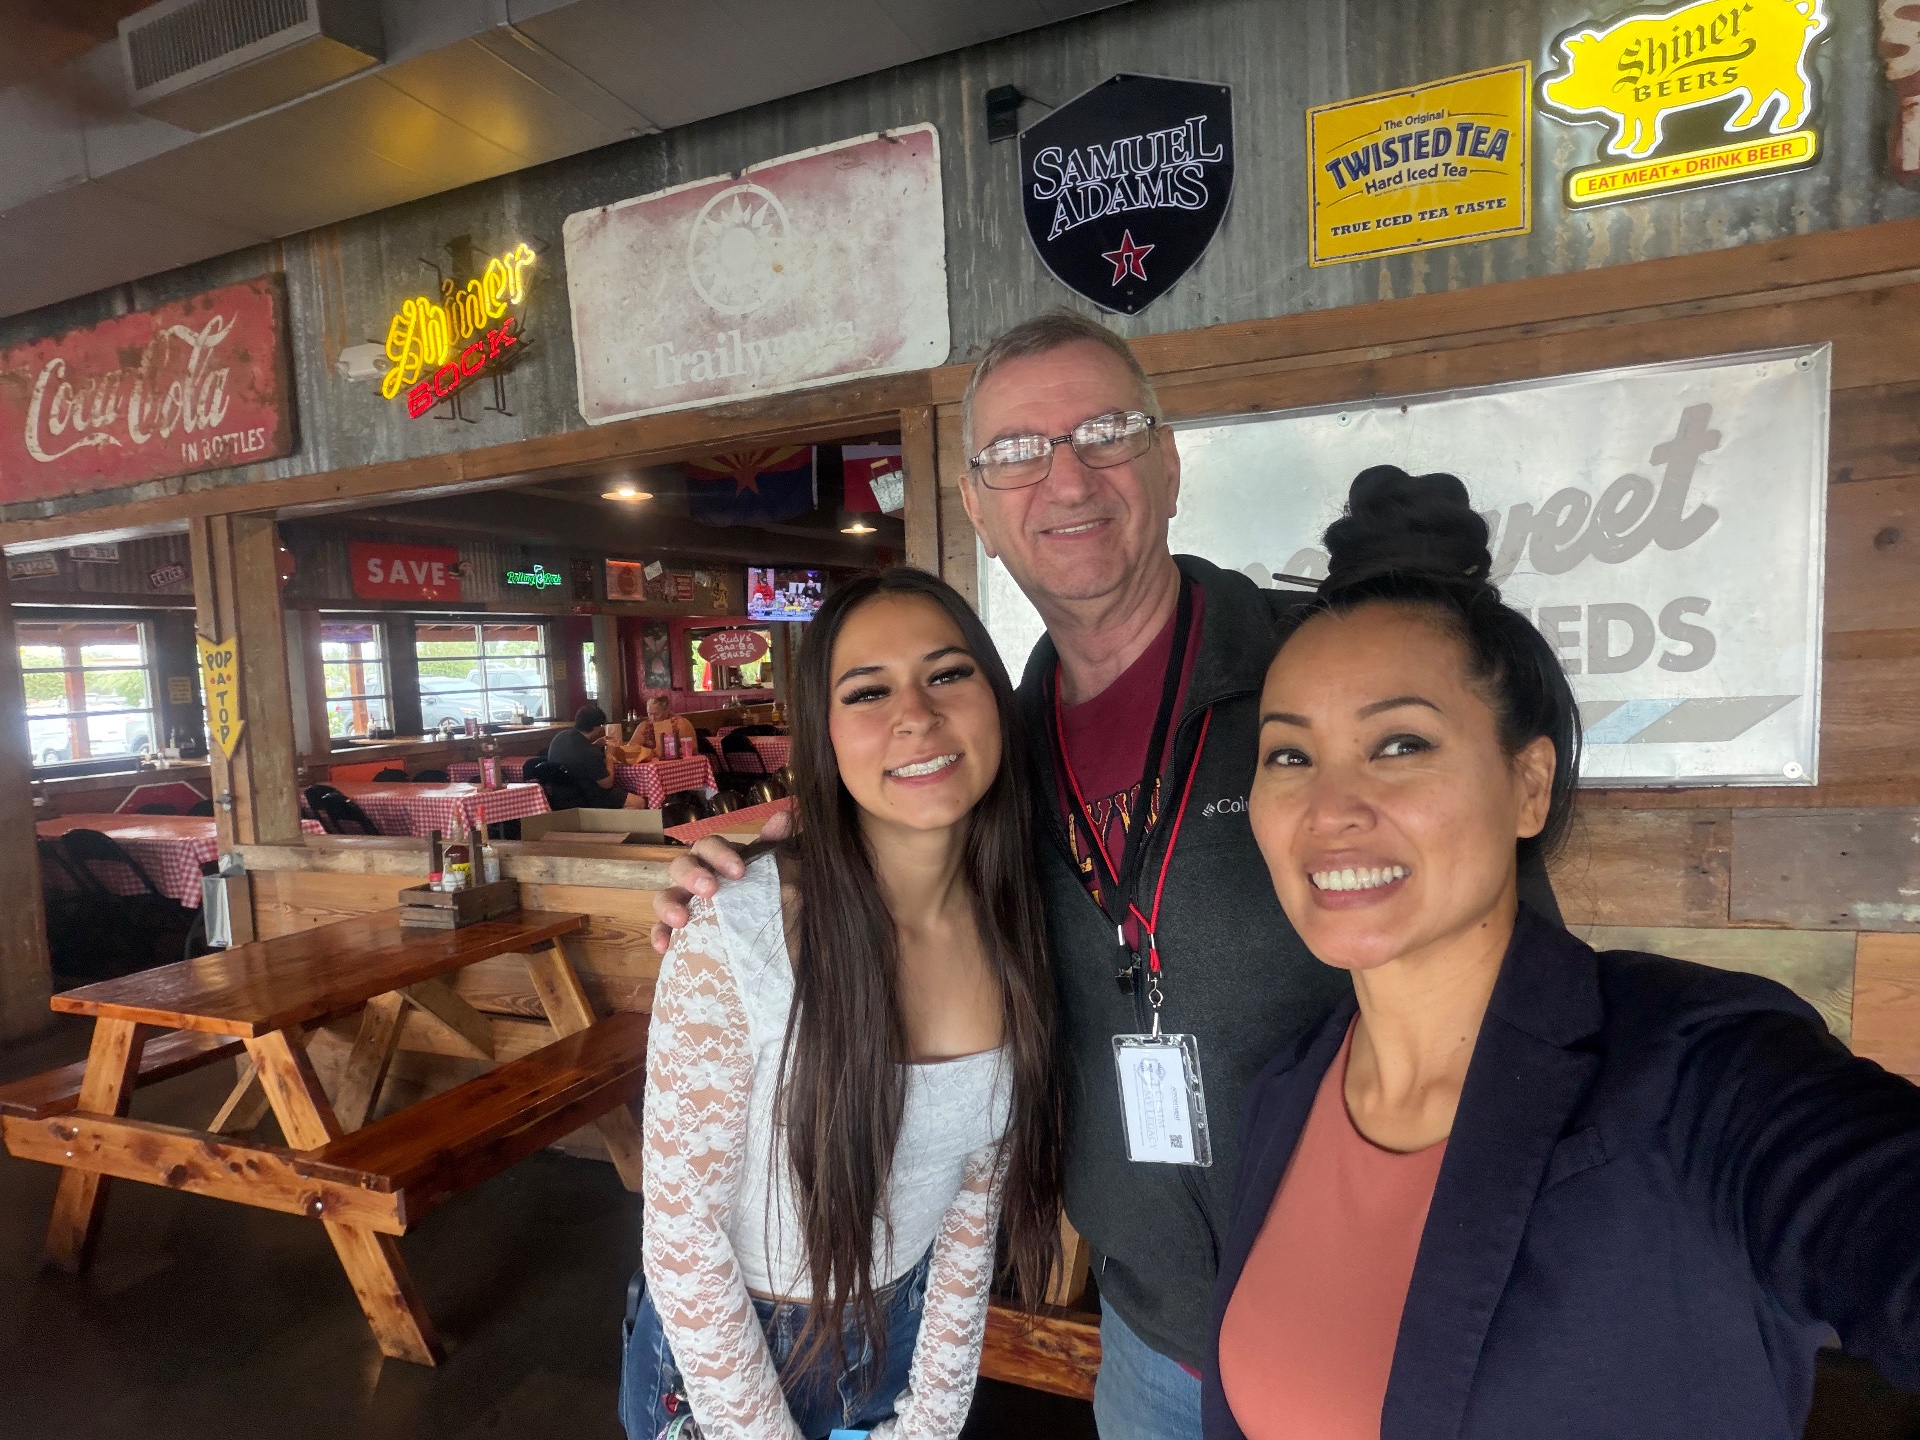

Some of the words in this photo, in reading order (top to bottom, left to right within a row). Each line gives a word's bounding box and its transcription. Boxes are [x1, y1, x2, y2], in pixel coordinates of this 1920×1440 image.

[1613, 3, 1754, 93] Shiner
[1633, 66, 1739, 103] BEERS
[1384, 119, 1403, 131] The
[1404, 109, 1445, 127] Original
[1033, 115, 1224, 200] SAMUEL
[1325, 127, 1452, 190] TWISTED
[1456, 122, 1510, 162] TEA
[1588, 174, 1618, 192] EAT
[1622, 165, 1668, 187] MEAT
[1685, 154, 1743, 175] DRINK
[1747, 143, 1793, 163] BEER
[1365, 170, 1403, 195] Hard
[1407, 163, 1439, 182] Iced
[1442, 162, 1468, 177] Tea
[1047, 162, 1209, 241] ADAMS
[1330, 221, 1372, 237] TRUE
[1375, 213, 1413, 229] ICED
[1418, 207, 1449, 221] TEA
[1455, 198, 1507, 215] TASTE
[382, 243, 536, 400] Shiner
[408, 317, 518, 419] BOCK
[182, 442, 199, 463] IN
[201, 428, 266, 460] BOTTLES
[367, 557, 446, 586] SAVE
[507, 571, 536, 586] Rolling
[545, 572, 562, 585] Rock
[205, 650, 232, 671] POP
[217, 672, 226, 686] A
[216, 690, 230, 745] TOP
